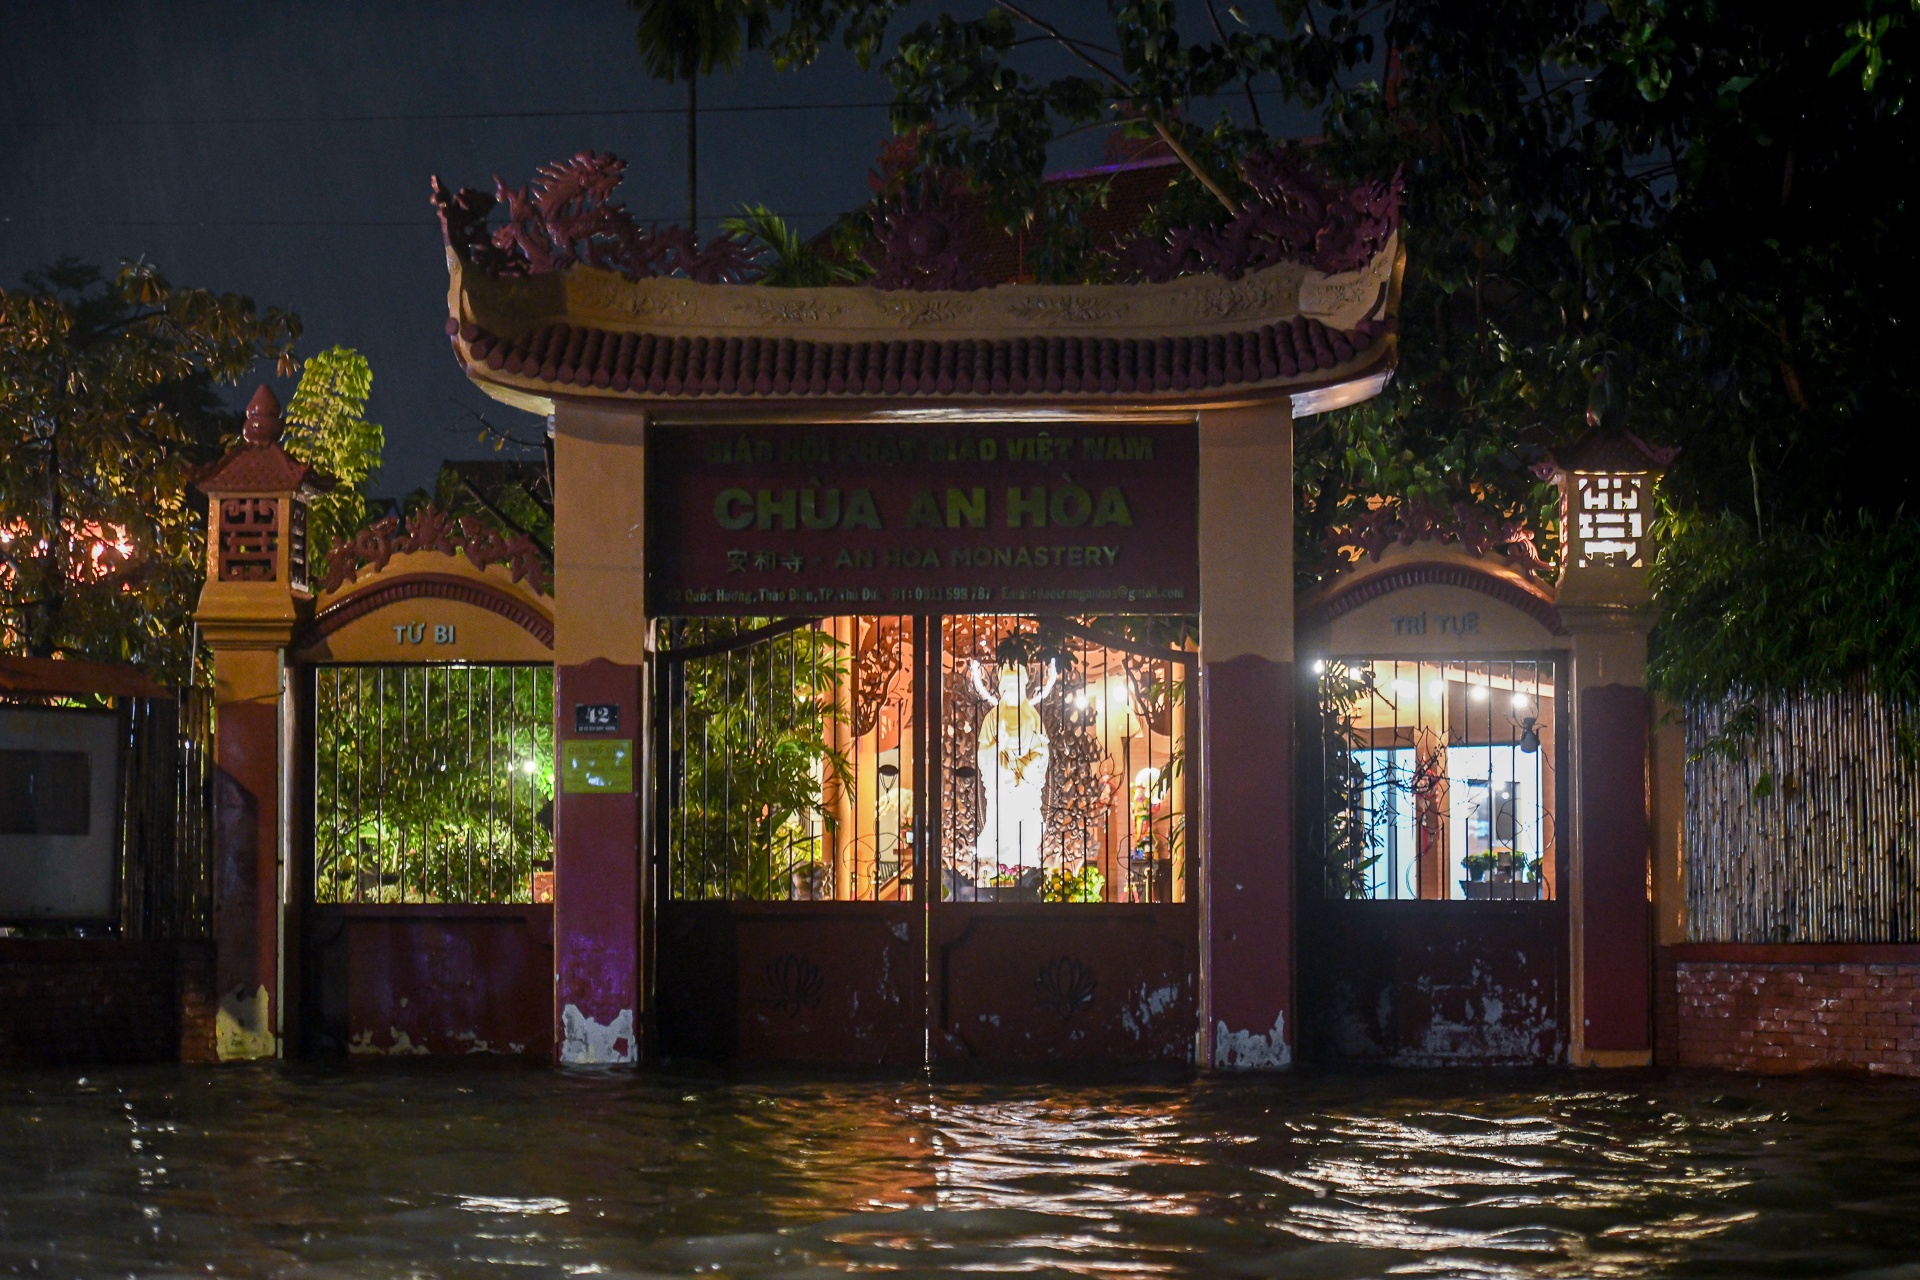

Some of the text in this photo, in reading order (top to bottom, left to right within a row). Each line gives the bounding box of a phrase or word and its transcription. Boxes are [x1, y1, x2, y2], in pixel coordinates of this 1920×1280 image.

[1006, 431, 1073, 466] VIỆT
[1082, 436, 1156, 462] NAM
[713, 472, 1134, 531] CHÙA AN HÒA
[726, 547, 805, 575] 安和寺
[833, 546, 876, 569] AN
[884, 546, 942, 569] HOA
[951, 545, 1120, 570] MONASTERY
[946, 586, 968, 601] 598
[392, 620, 456, 645] TỪ BI
[1391, 611, 1427, 635] TRÍ
[585, 707, 610, 724] 42
